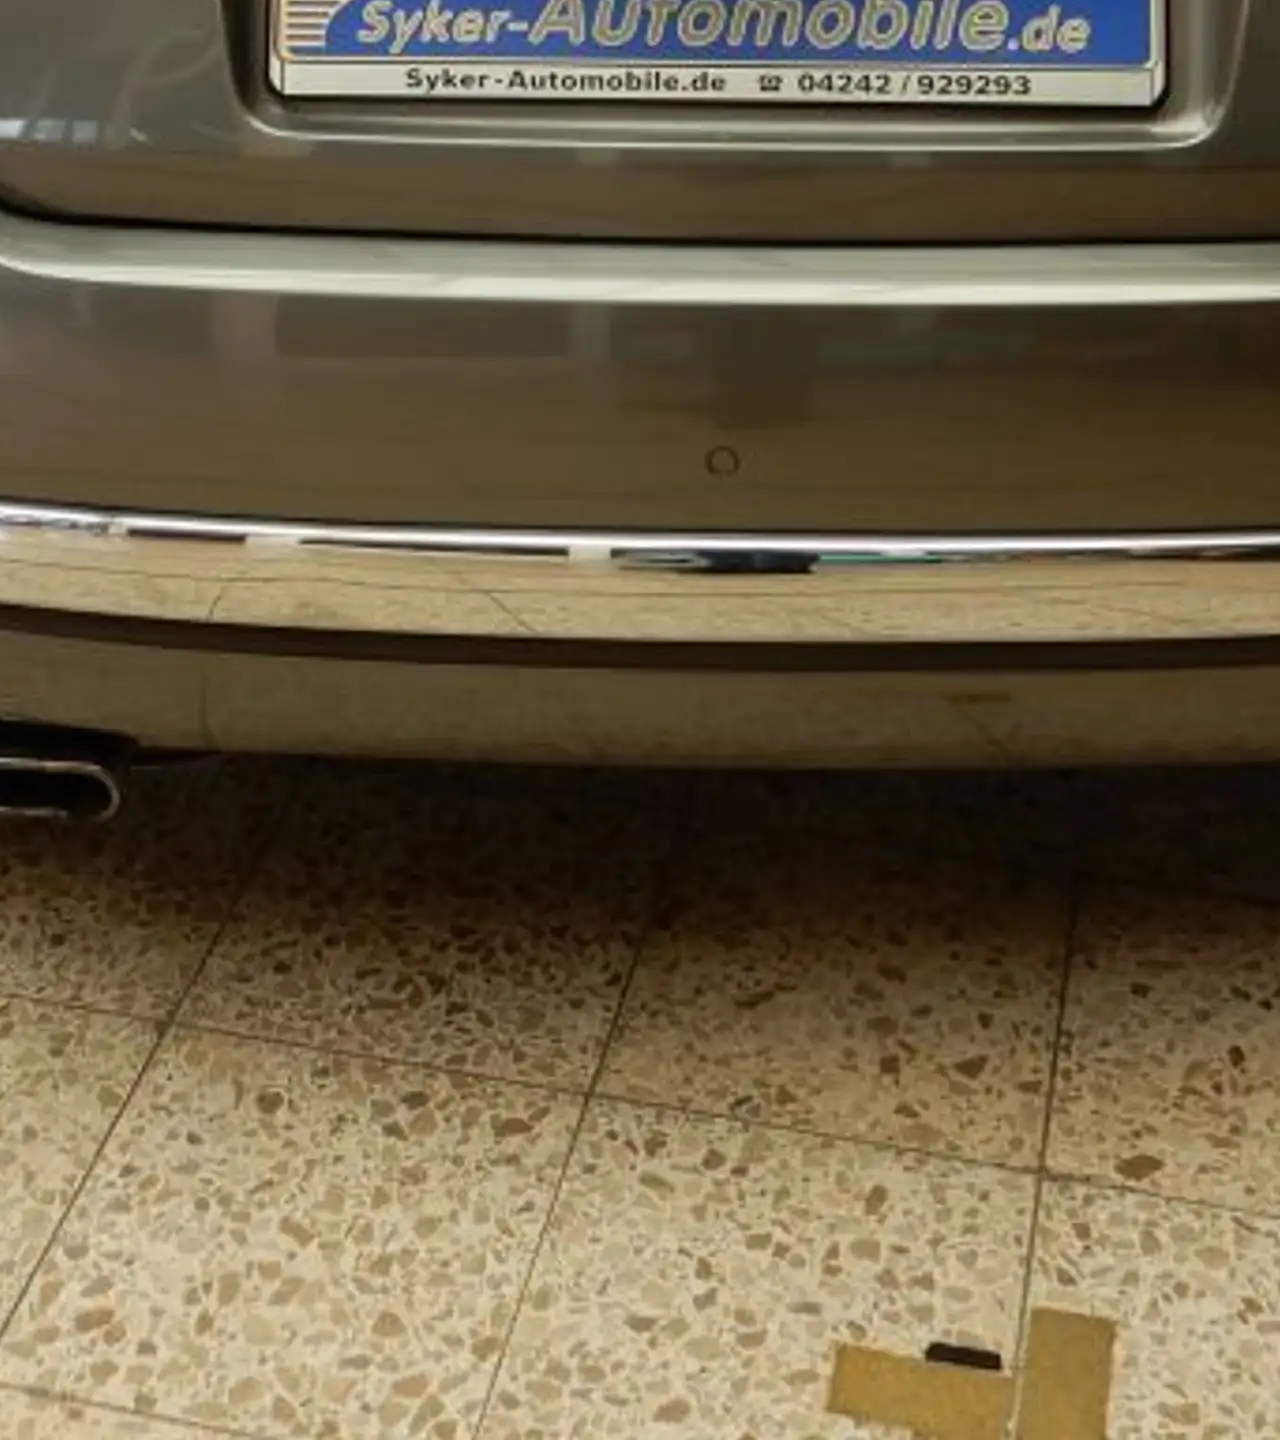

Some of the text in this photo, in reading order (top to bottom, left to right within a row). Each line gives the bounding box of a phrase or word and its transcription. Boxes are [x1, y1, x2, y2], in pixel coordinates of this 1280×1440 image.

[405, 69, 726, 94] Syker-Automobile.de
[797, 73, 891, 95] 04242
[918, 73, 1031, 96] 929293
